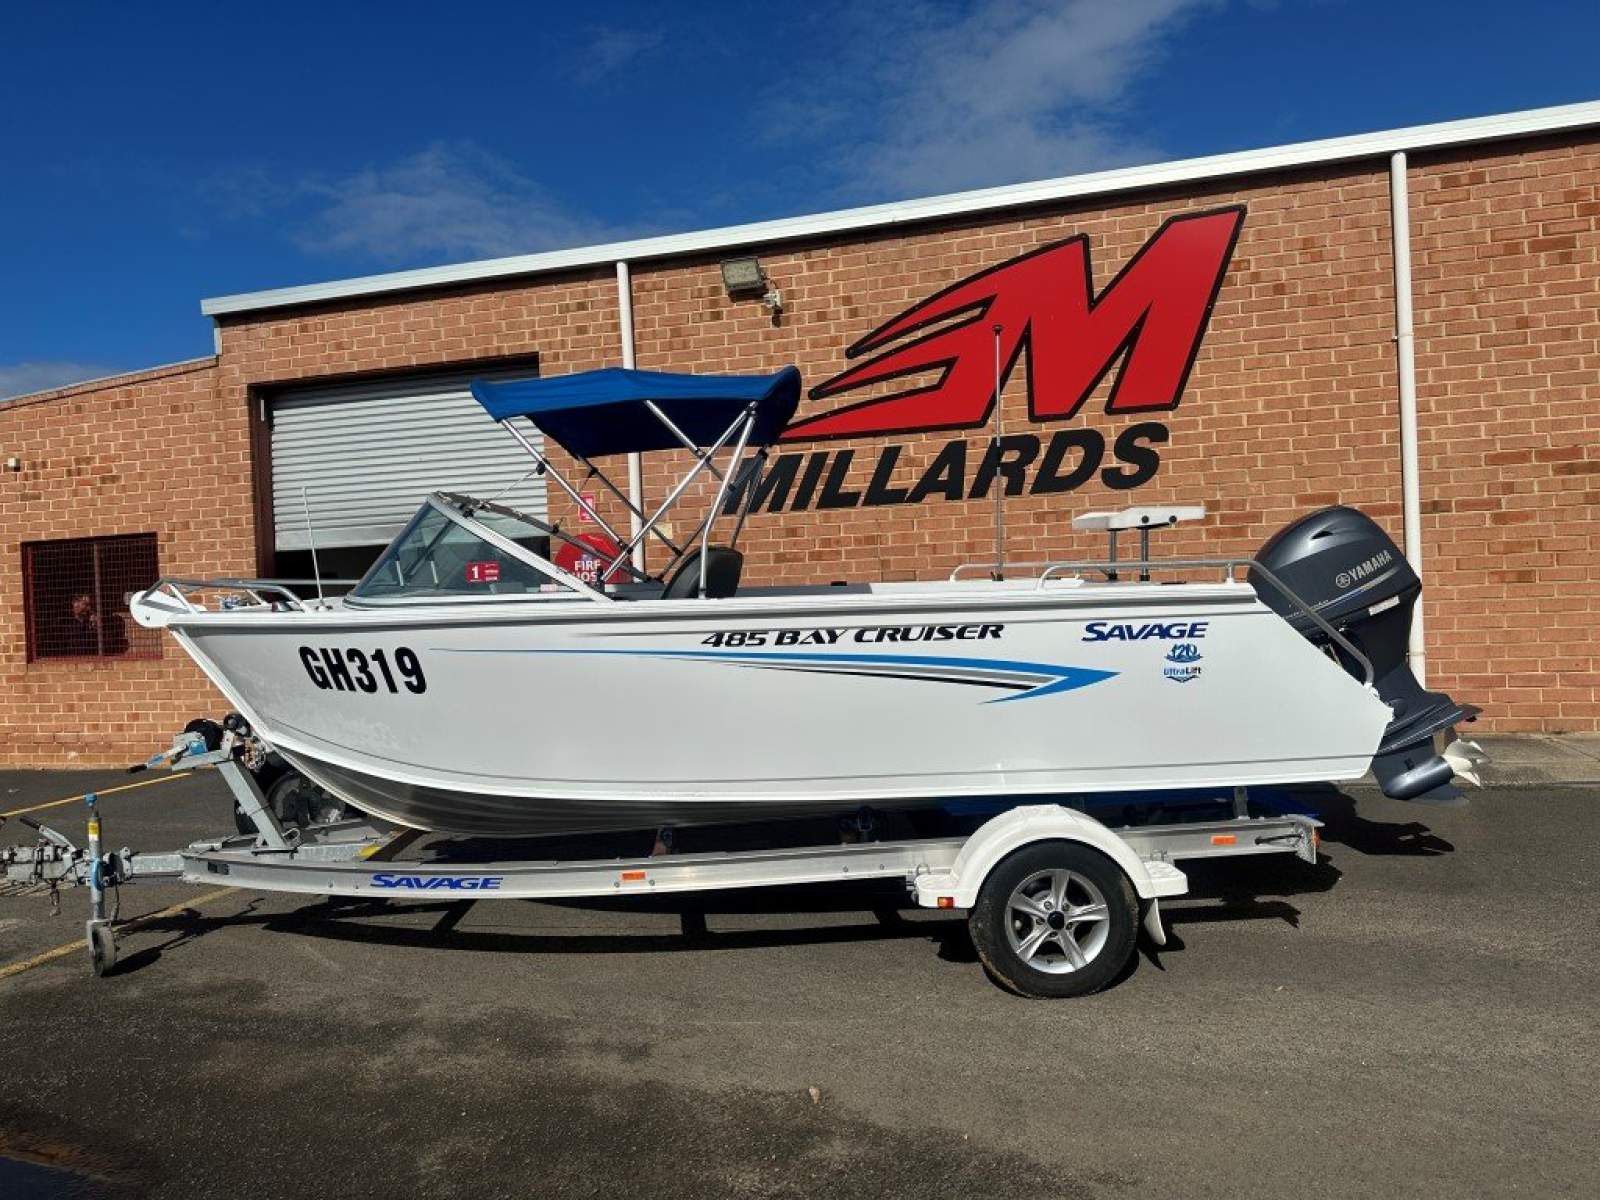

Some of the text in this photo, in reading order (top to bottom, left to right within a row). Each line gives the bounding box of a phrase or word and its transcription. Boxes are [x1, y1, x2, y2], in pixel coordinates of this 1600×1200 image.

[721, 421, 1169, 515] MILLARDS
[1349, 550, 1393, 581] YAMAHA
[701, 624, 1005, 647] 485 BAY CRUISER
[1081, 622, 1209, 642] SAVAGE
[298, 646, 427, 694] GH319
[370, 874, 504, 890] SAVAGE
